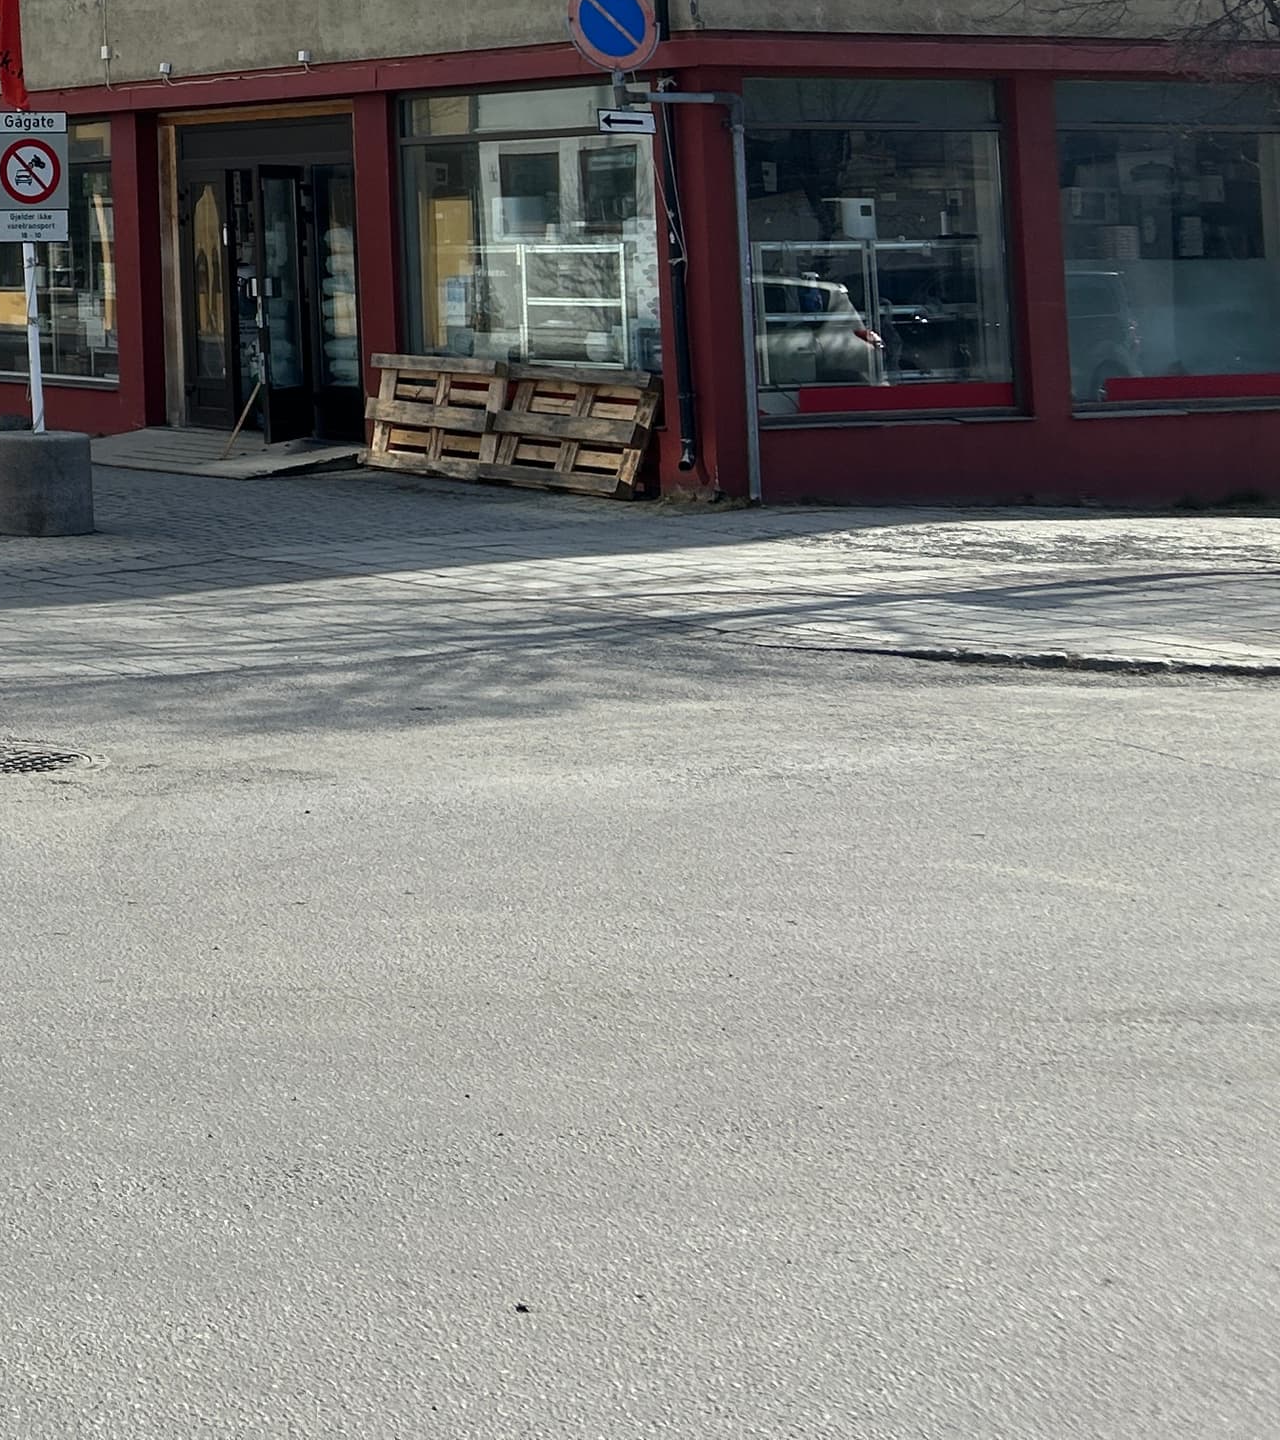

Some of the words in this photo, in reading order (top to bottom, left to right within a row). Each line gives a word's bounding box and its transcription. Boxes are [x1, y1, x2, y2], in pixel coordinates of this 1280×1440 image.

[4, 114, 55, 131] Gågate
[9, 213, 35, 223] Gjelder
[7, 223, 56, 231] varetransport
